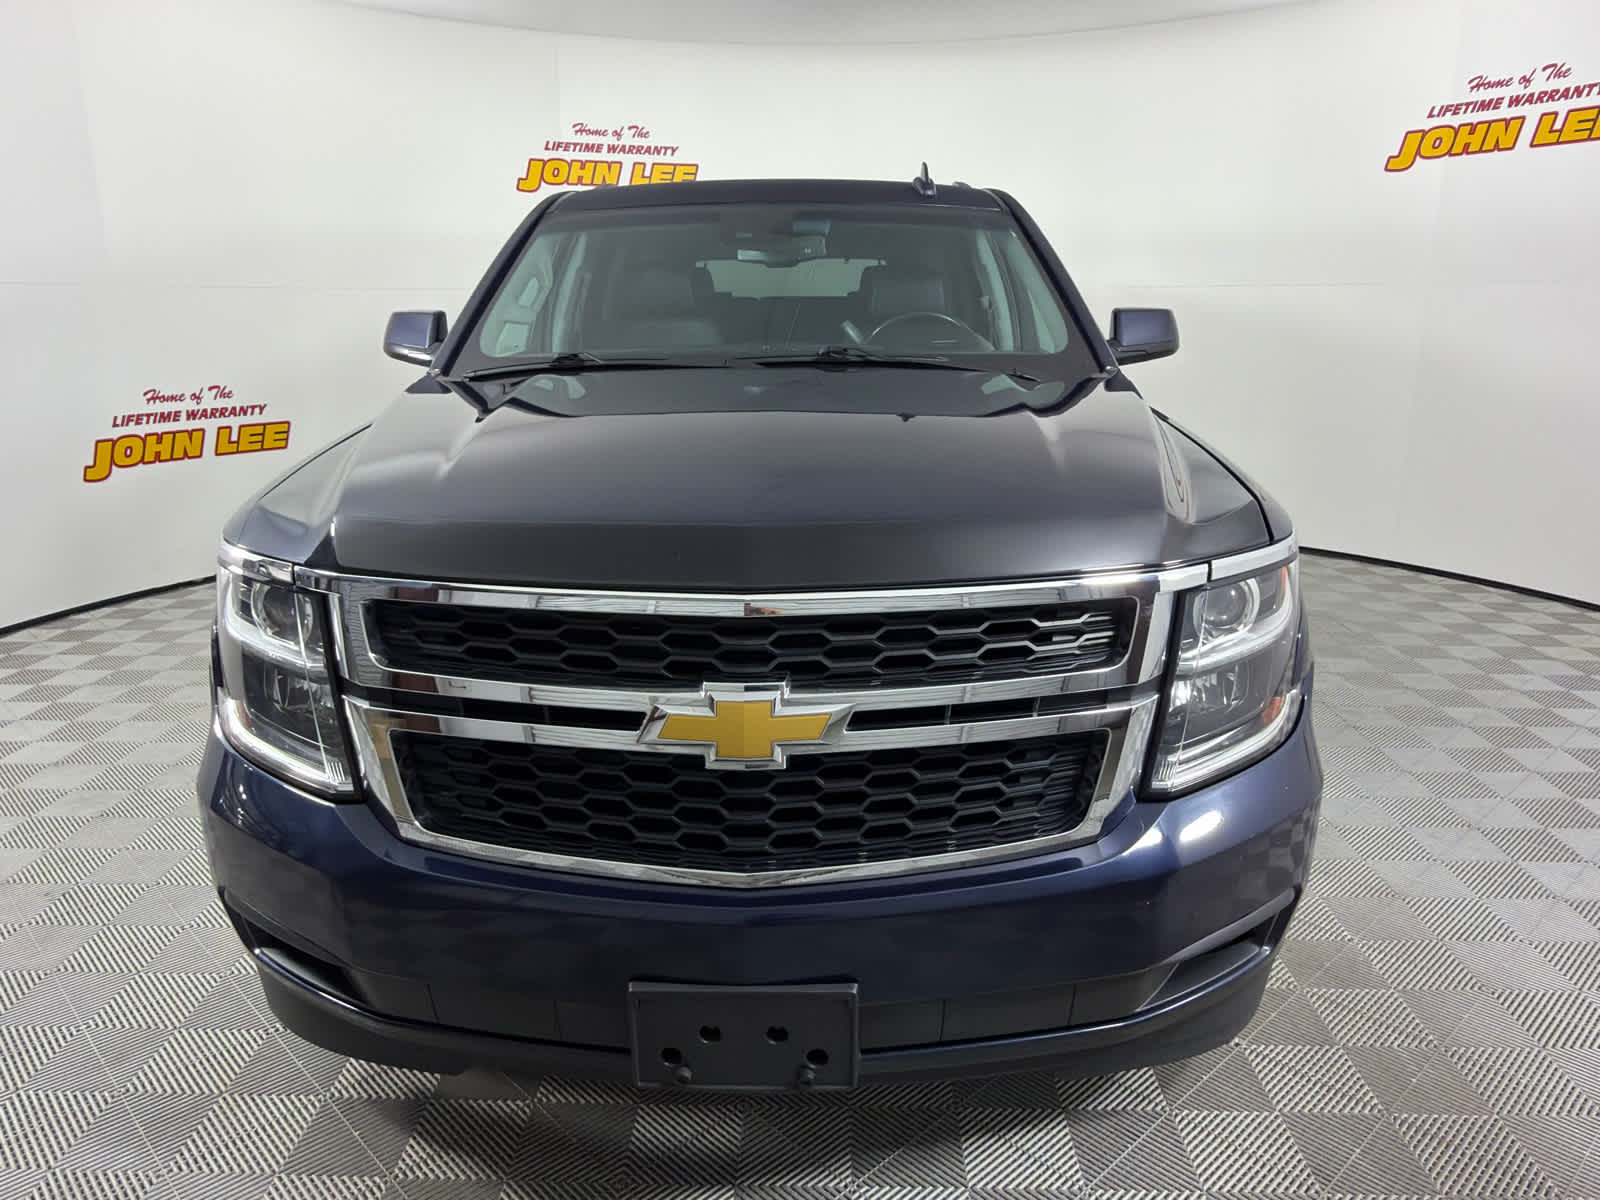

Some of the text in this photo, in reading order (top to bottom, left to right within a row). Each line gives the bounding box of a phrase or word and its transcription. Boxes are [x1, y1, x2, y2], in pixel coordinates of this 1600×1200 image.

[1467, 62, 1572, 93] Home of The
[1427, 81, 1600, 119] LIFETIME WARRANT
[572, 122, 650, 141] Home of The
[1384, 105, 1600, 172] JOHN LE
[544, 141, 679, 157] LIFETIME WARRANTY
[516, 158, 622, 193] JOHN
[143, 385, 234, 405] Home of The
[112, 404, 267, 428] LIFETIME WARRANTY
[83, 420, 290, 482] JOHN LEE
